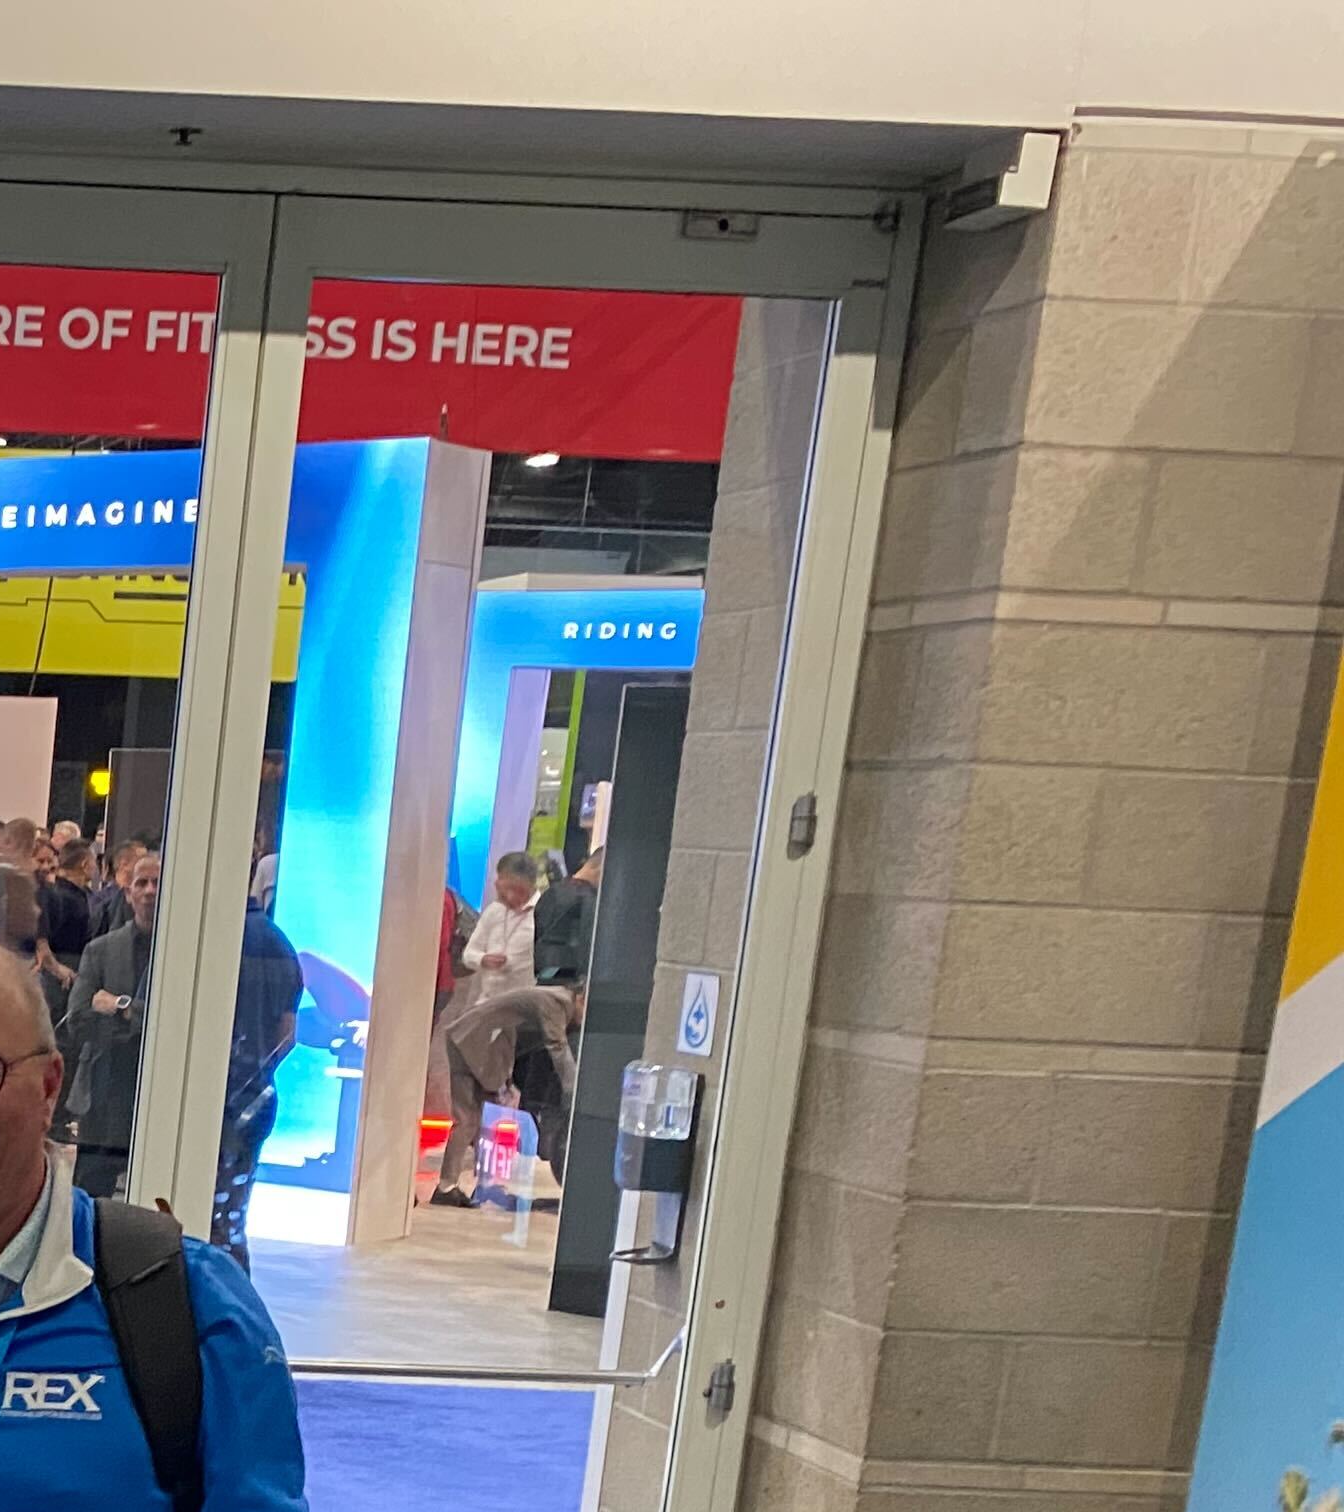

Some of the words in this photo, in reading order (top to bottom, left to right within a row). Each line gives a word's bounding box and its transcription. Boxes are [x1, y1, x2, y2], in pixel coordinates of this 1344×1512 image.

[58, 307, 133, 350] OF
[371, 318, 417, 362] IS
[430, 321, 573, 369] HERE
[562, 620, 678, 641] RIDING
[0, 1371, 105, 1412] REX
